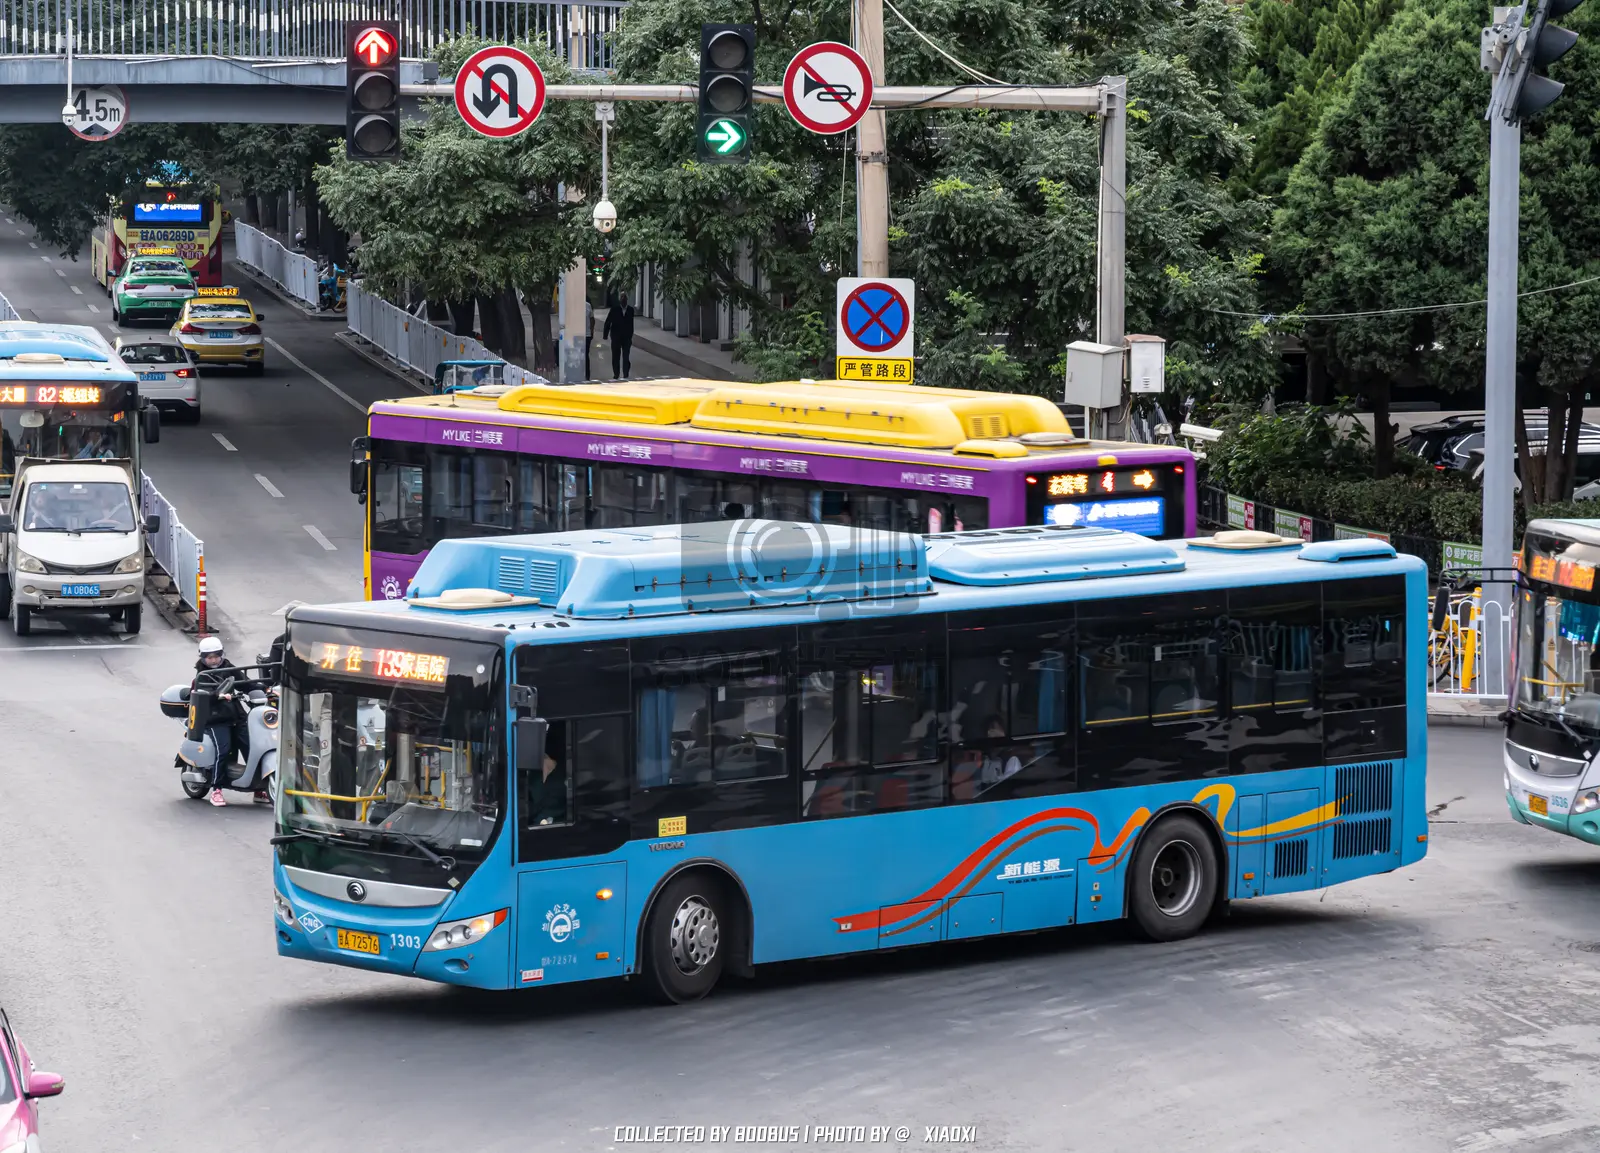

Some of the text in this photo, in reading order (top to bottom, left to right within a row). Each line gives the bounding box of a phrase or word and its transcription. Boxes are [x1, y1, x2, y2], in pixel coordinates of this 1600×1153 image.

[73, 90, 120, 122] 4.5m
[140, 230, 195, 242] 甘A06289D
[844, 362, 906, 378] 严管路段
[38, 386, 57, 403] 82
[648, 840, 685, 852] YUTONG
[1004, 858, 1060, 876] 新能源
[303, 917, 319, 928] CNG
[390, 933, 421, 949] 1303
